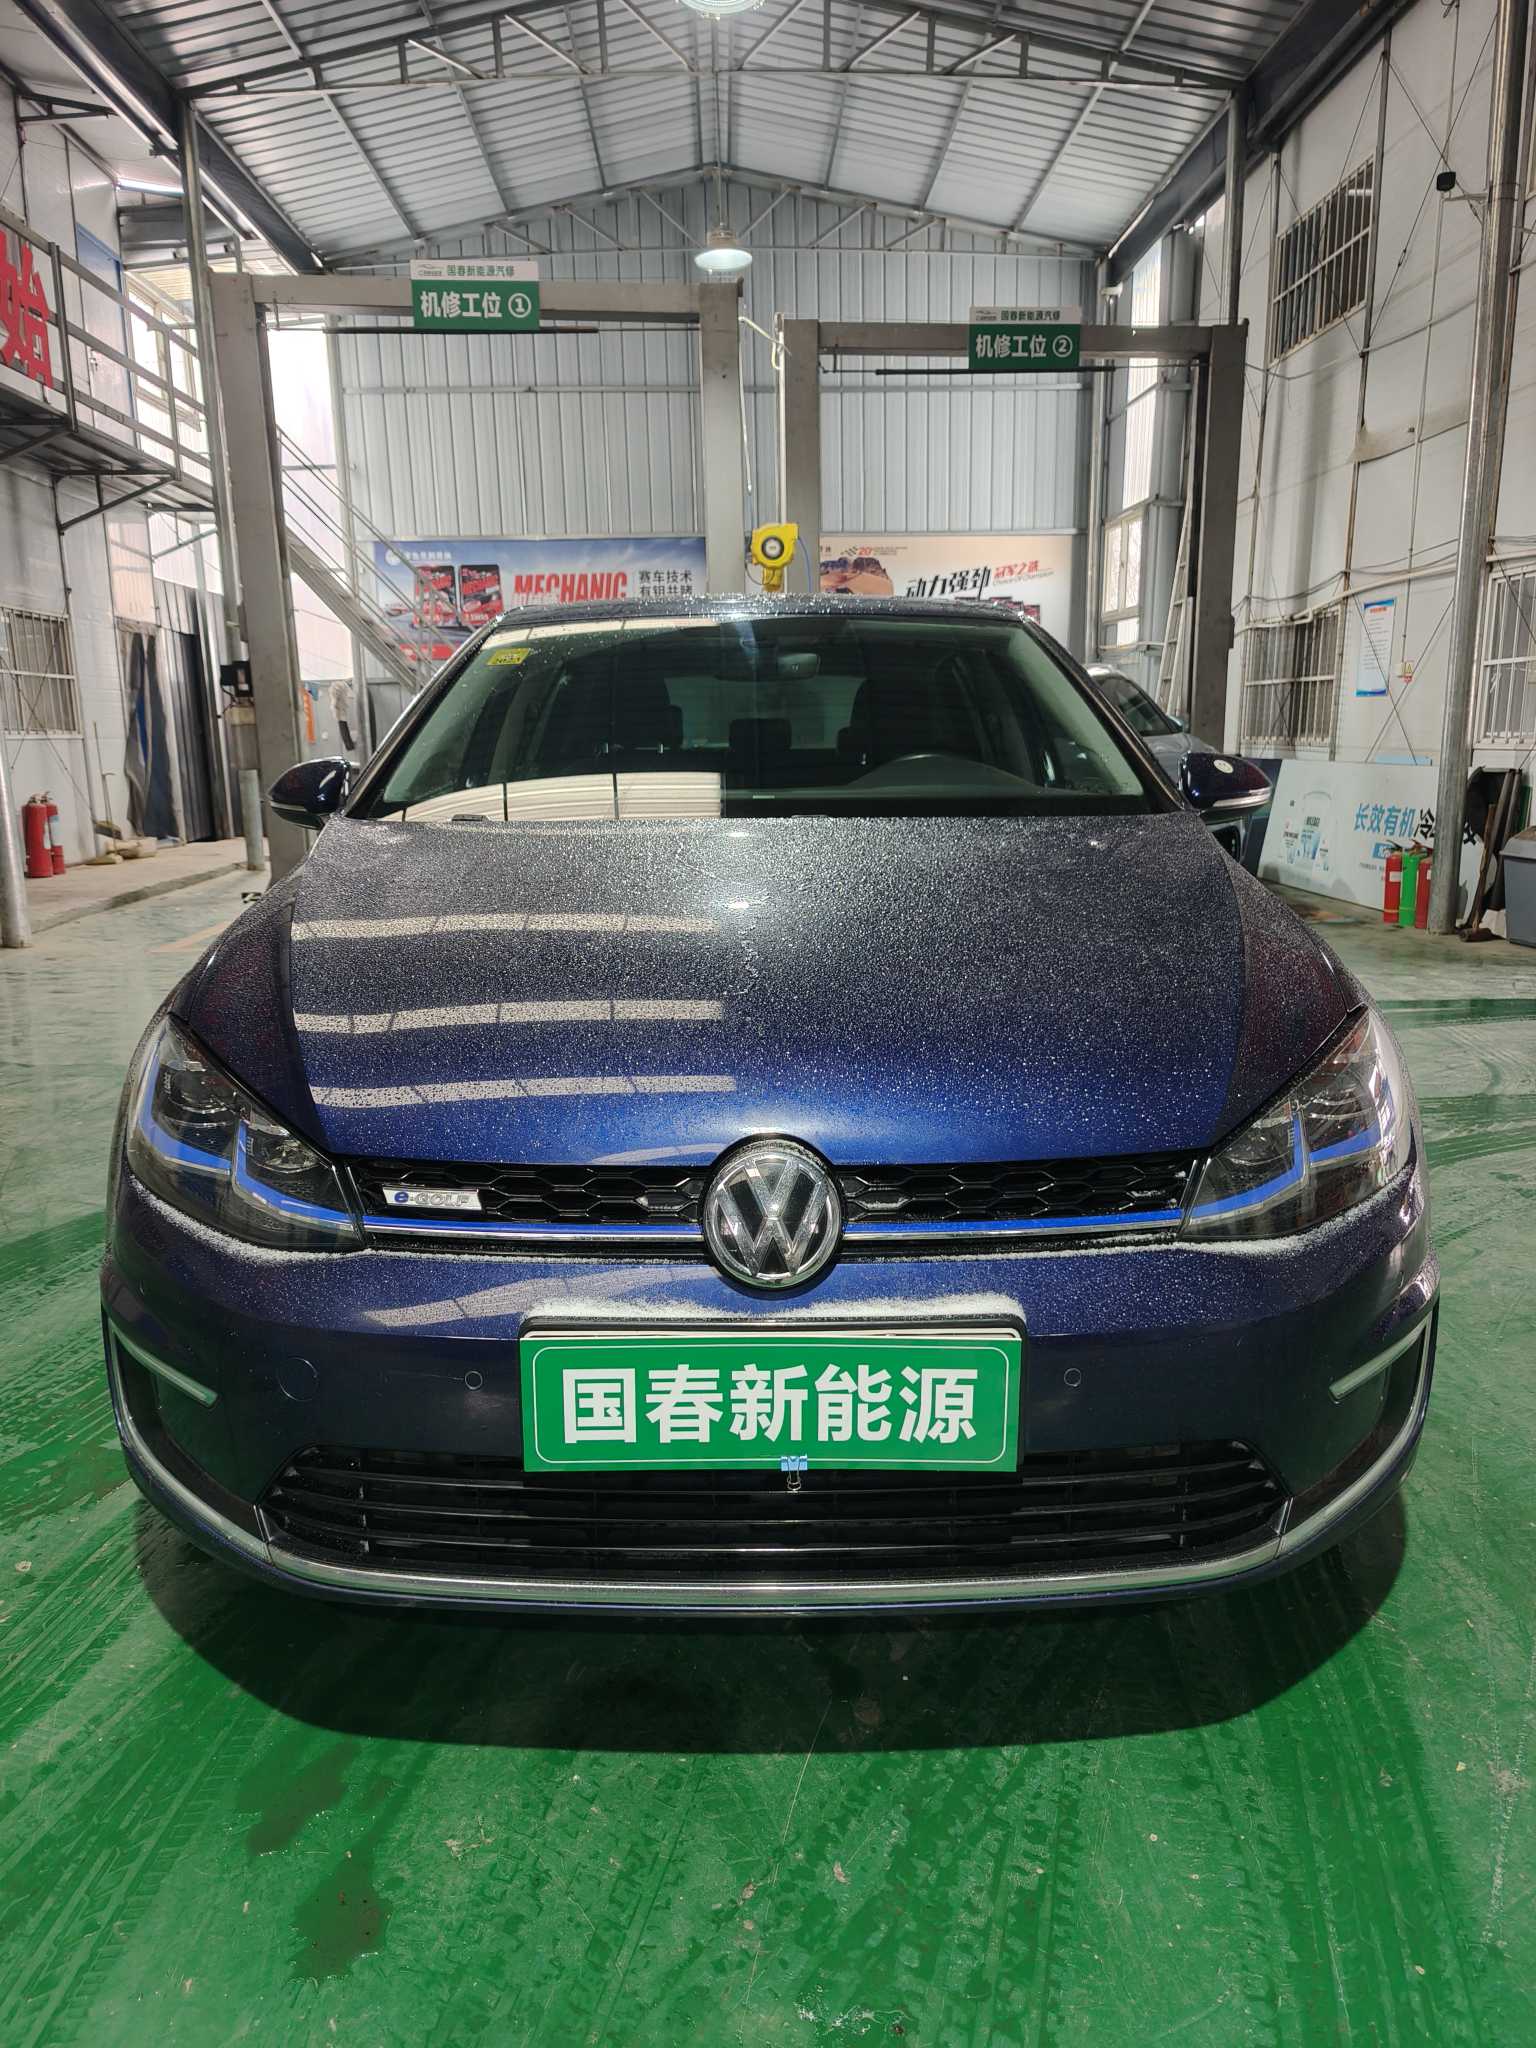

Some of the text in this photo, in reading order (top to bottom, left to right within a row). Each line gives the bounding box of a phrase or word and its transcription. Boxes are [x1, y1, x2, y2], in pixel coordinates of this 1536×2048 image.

[514, 572, 628, 603] MECHANIC
[639, 569, 692, 584] 赛车技术
[562, 1364, 978, 1445] 国春新能源
